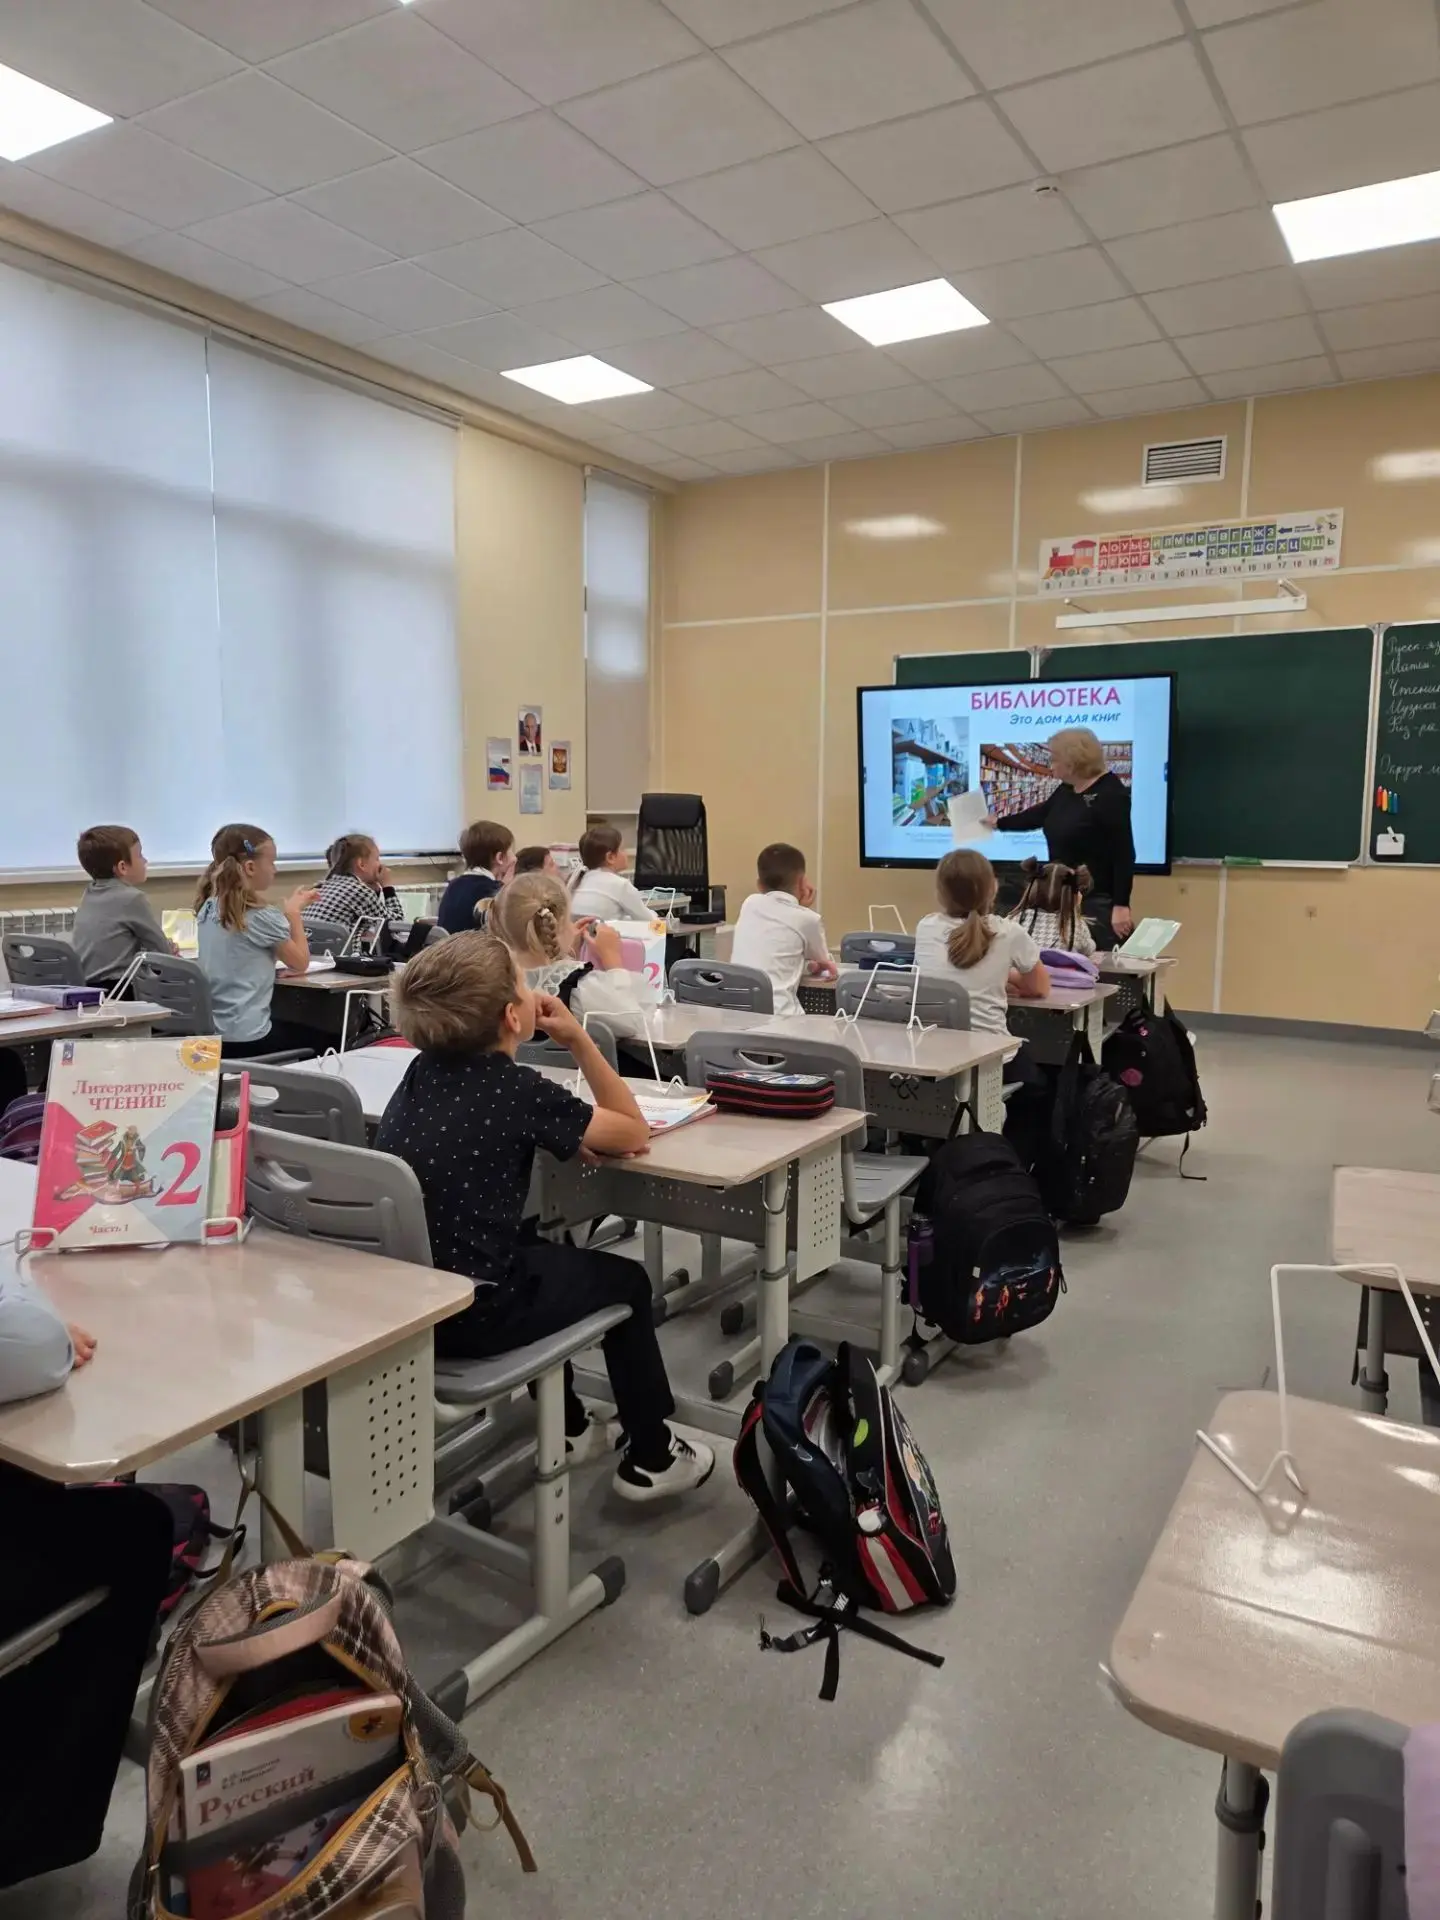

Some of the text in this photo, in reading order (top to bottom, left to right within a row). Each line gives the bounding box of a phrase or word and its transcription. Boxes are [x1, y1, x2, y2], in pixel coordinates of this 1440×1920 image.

[971, 686, 1121, 710] БИБЛИОТЕКА
[1009, 712, 1122, 725] Это дом для книг
[72, 1079, 185, 1096] Литературное
[88, 1094, 167, 1112] ЧТЕНИЕ
[155, 1141, 202, 1207] 2
[89, 1224, 122, 1235] Часть
[199, 1764, 316, 1826] Русский
